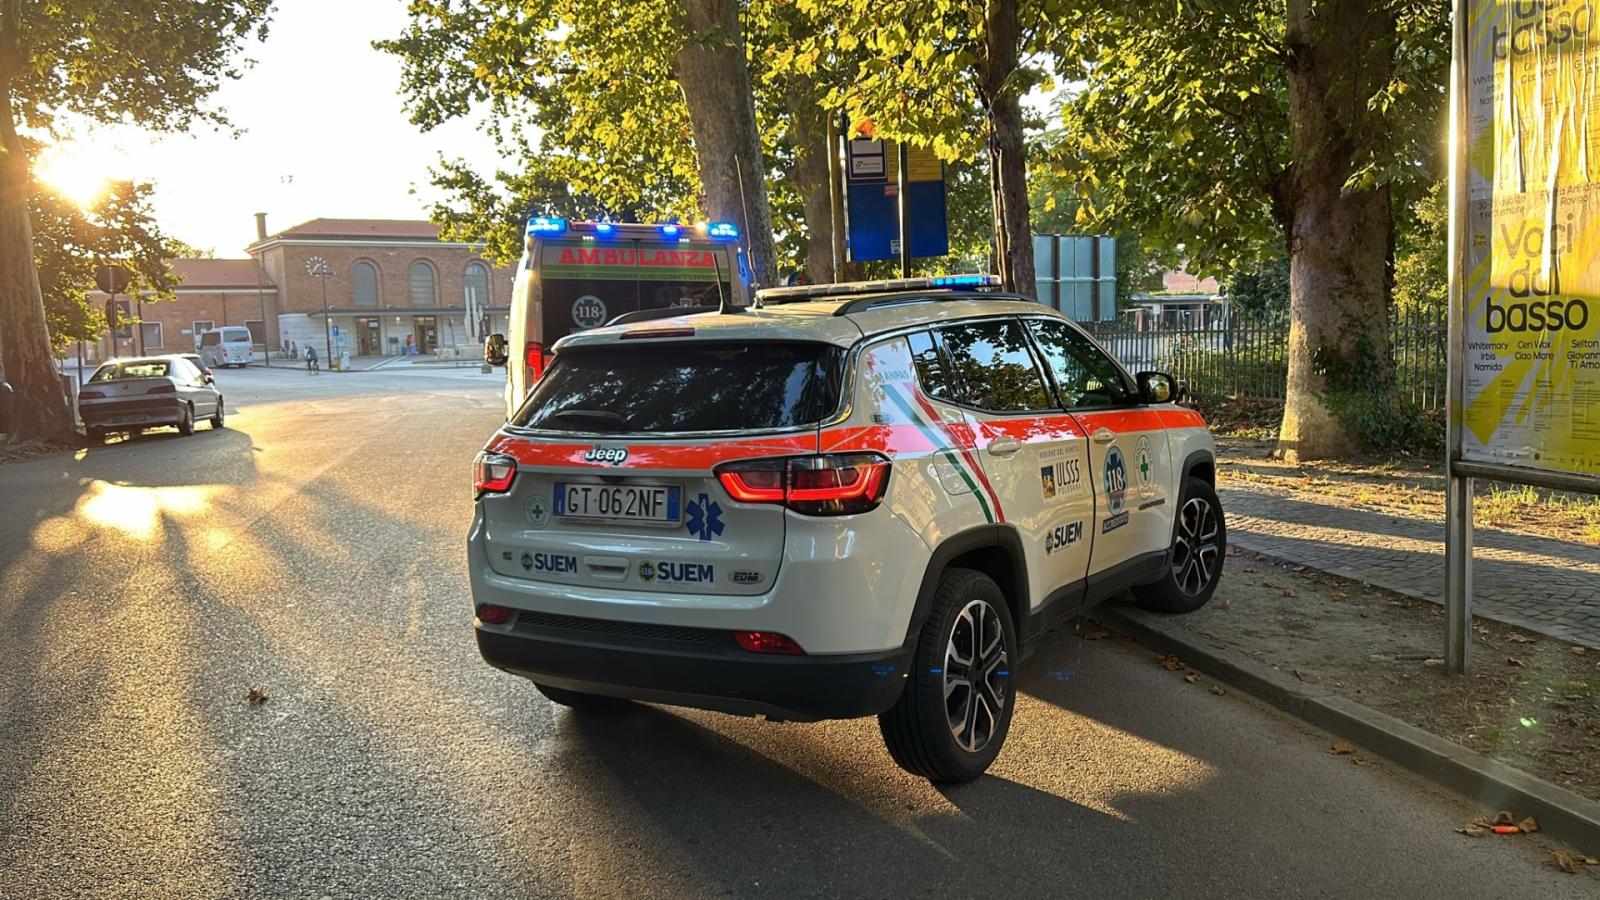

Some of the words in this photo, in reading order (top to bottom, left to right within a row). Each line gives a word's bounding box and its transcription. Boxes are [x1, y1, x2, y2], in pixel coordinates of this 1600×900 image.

[1501, 212, 1573, 260] Voci
[560, 248, 714, 267] AMBULANZA
[1509, 259, 1560, 298] dal
[578, 305, 600, 318] 118
[1486, 297, 1589, 333] basso
[1468, 341, 1508, 351] Whitemary
[1533, 351, 1554, 360] Mare
[1474, 363, 1503, 371] Namida
[585, 444, 627, 465] Jeep
[1107, 466, 1124, 493] 118
[1054, 521, 1082, 549] SUEM
[534, 552, 578, 574] SUEM
[656, 561, 714, 583] SUEM
[733, 571, 759, 582] EDM
